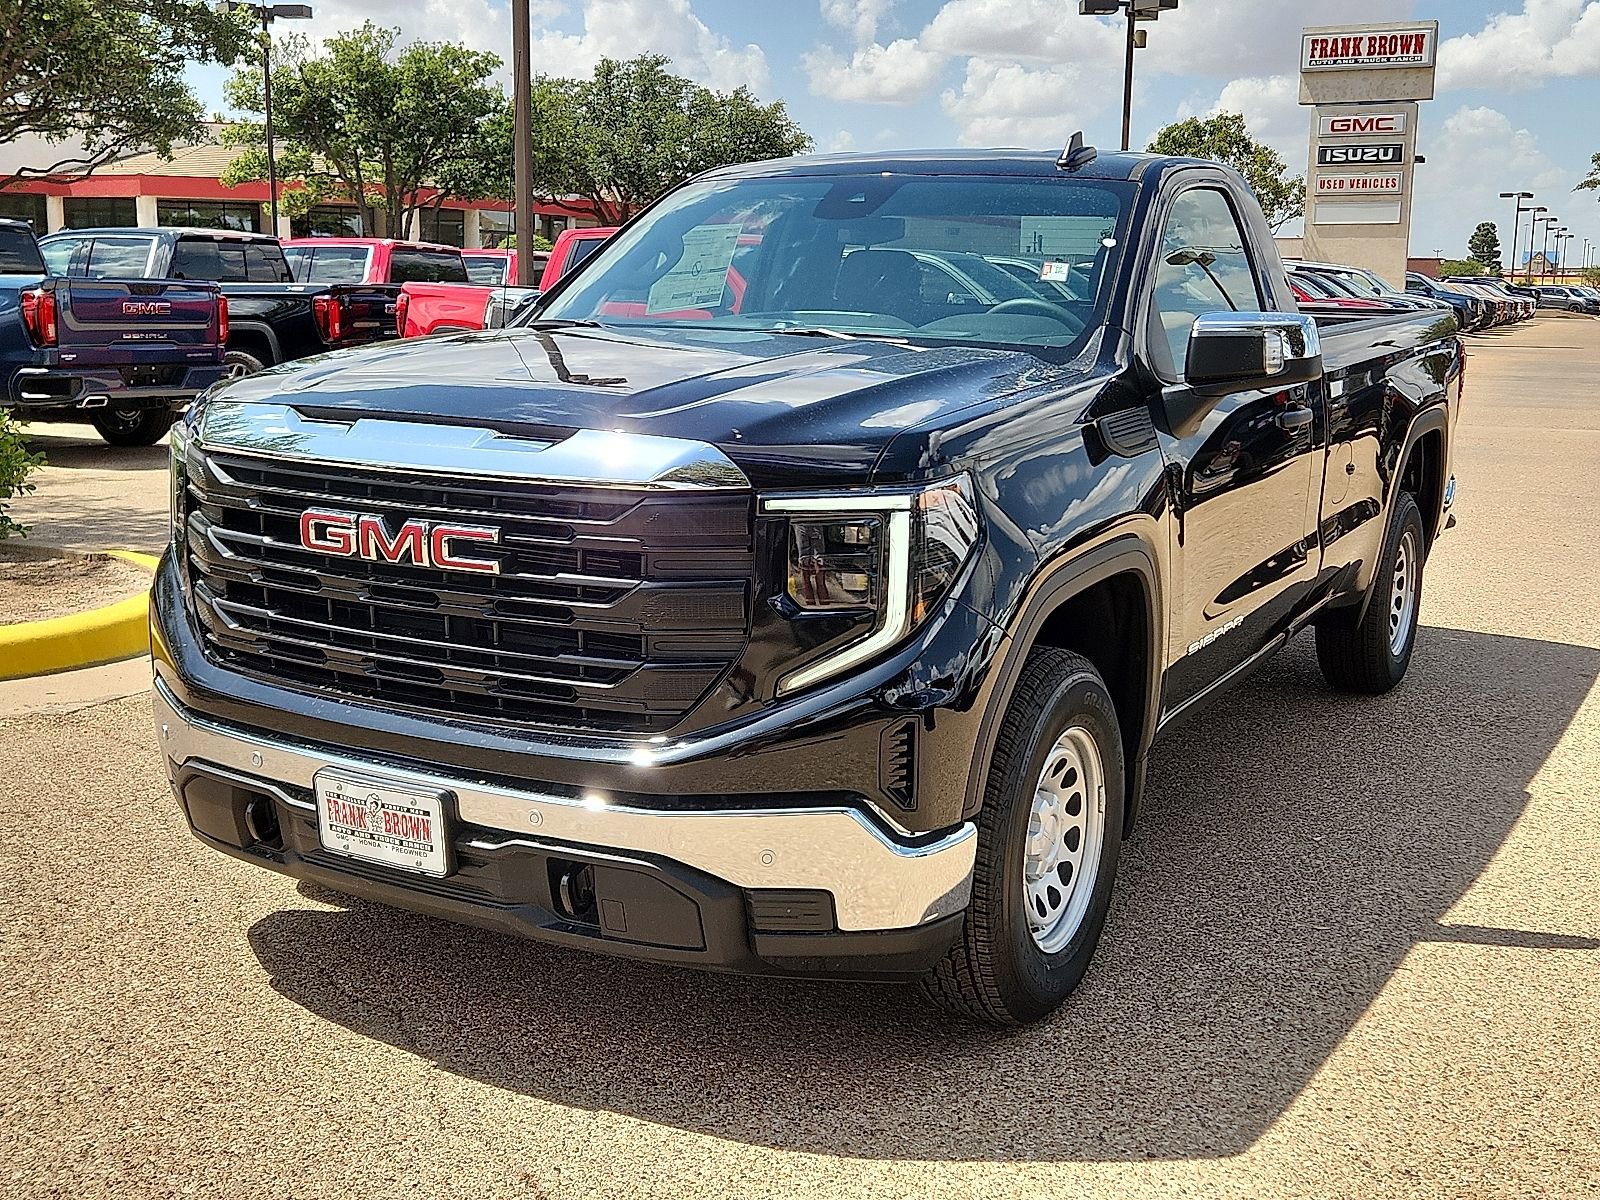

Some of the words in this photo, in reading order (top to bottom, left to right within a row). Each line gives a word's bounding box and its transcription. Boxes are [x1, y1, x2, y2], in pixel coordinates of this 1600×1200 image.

[1310, 37, 1364, 59] FRANK
[1366, 34, 1425, 56] BROWN
[1330, 117, 1395, 132] GMC
[1325, 148, 1394, 162] ISUZU
[1319, 179, 1345, 190] USED
[1349, 178, 1397, 189] VEHICLES
[122, 302, 171, 315] GMC
[300, 506, 501, 575] GMC
[1187, 615, 1244, 656] SIERRA
[326, 798, 369, 831] FRANK
[383, 811, 432, 843] BROWN
[331, 825, 352, 836] AUTO
[354, 831, 372, 840] AND
[373, 834, 401, 846] TRUCK
[402, 840, 432, 852] RANCH
[335, 833, 350, 842] GMC
[359, 839, 382, 849] HONDA
[391, 845, 428, 858] PREOWNED
